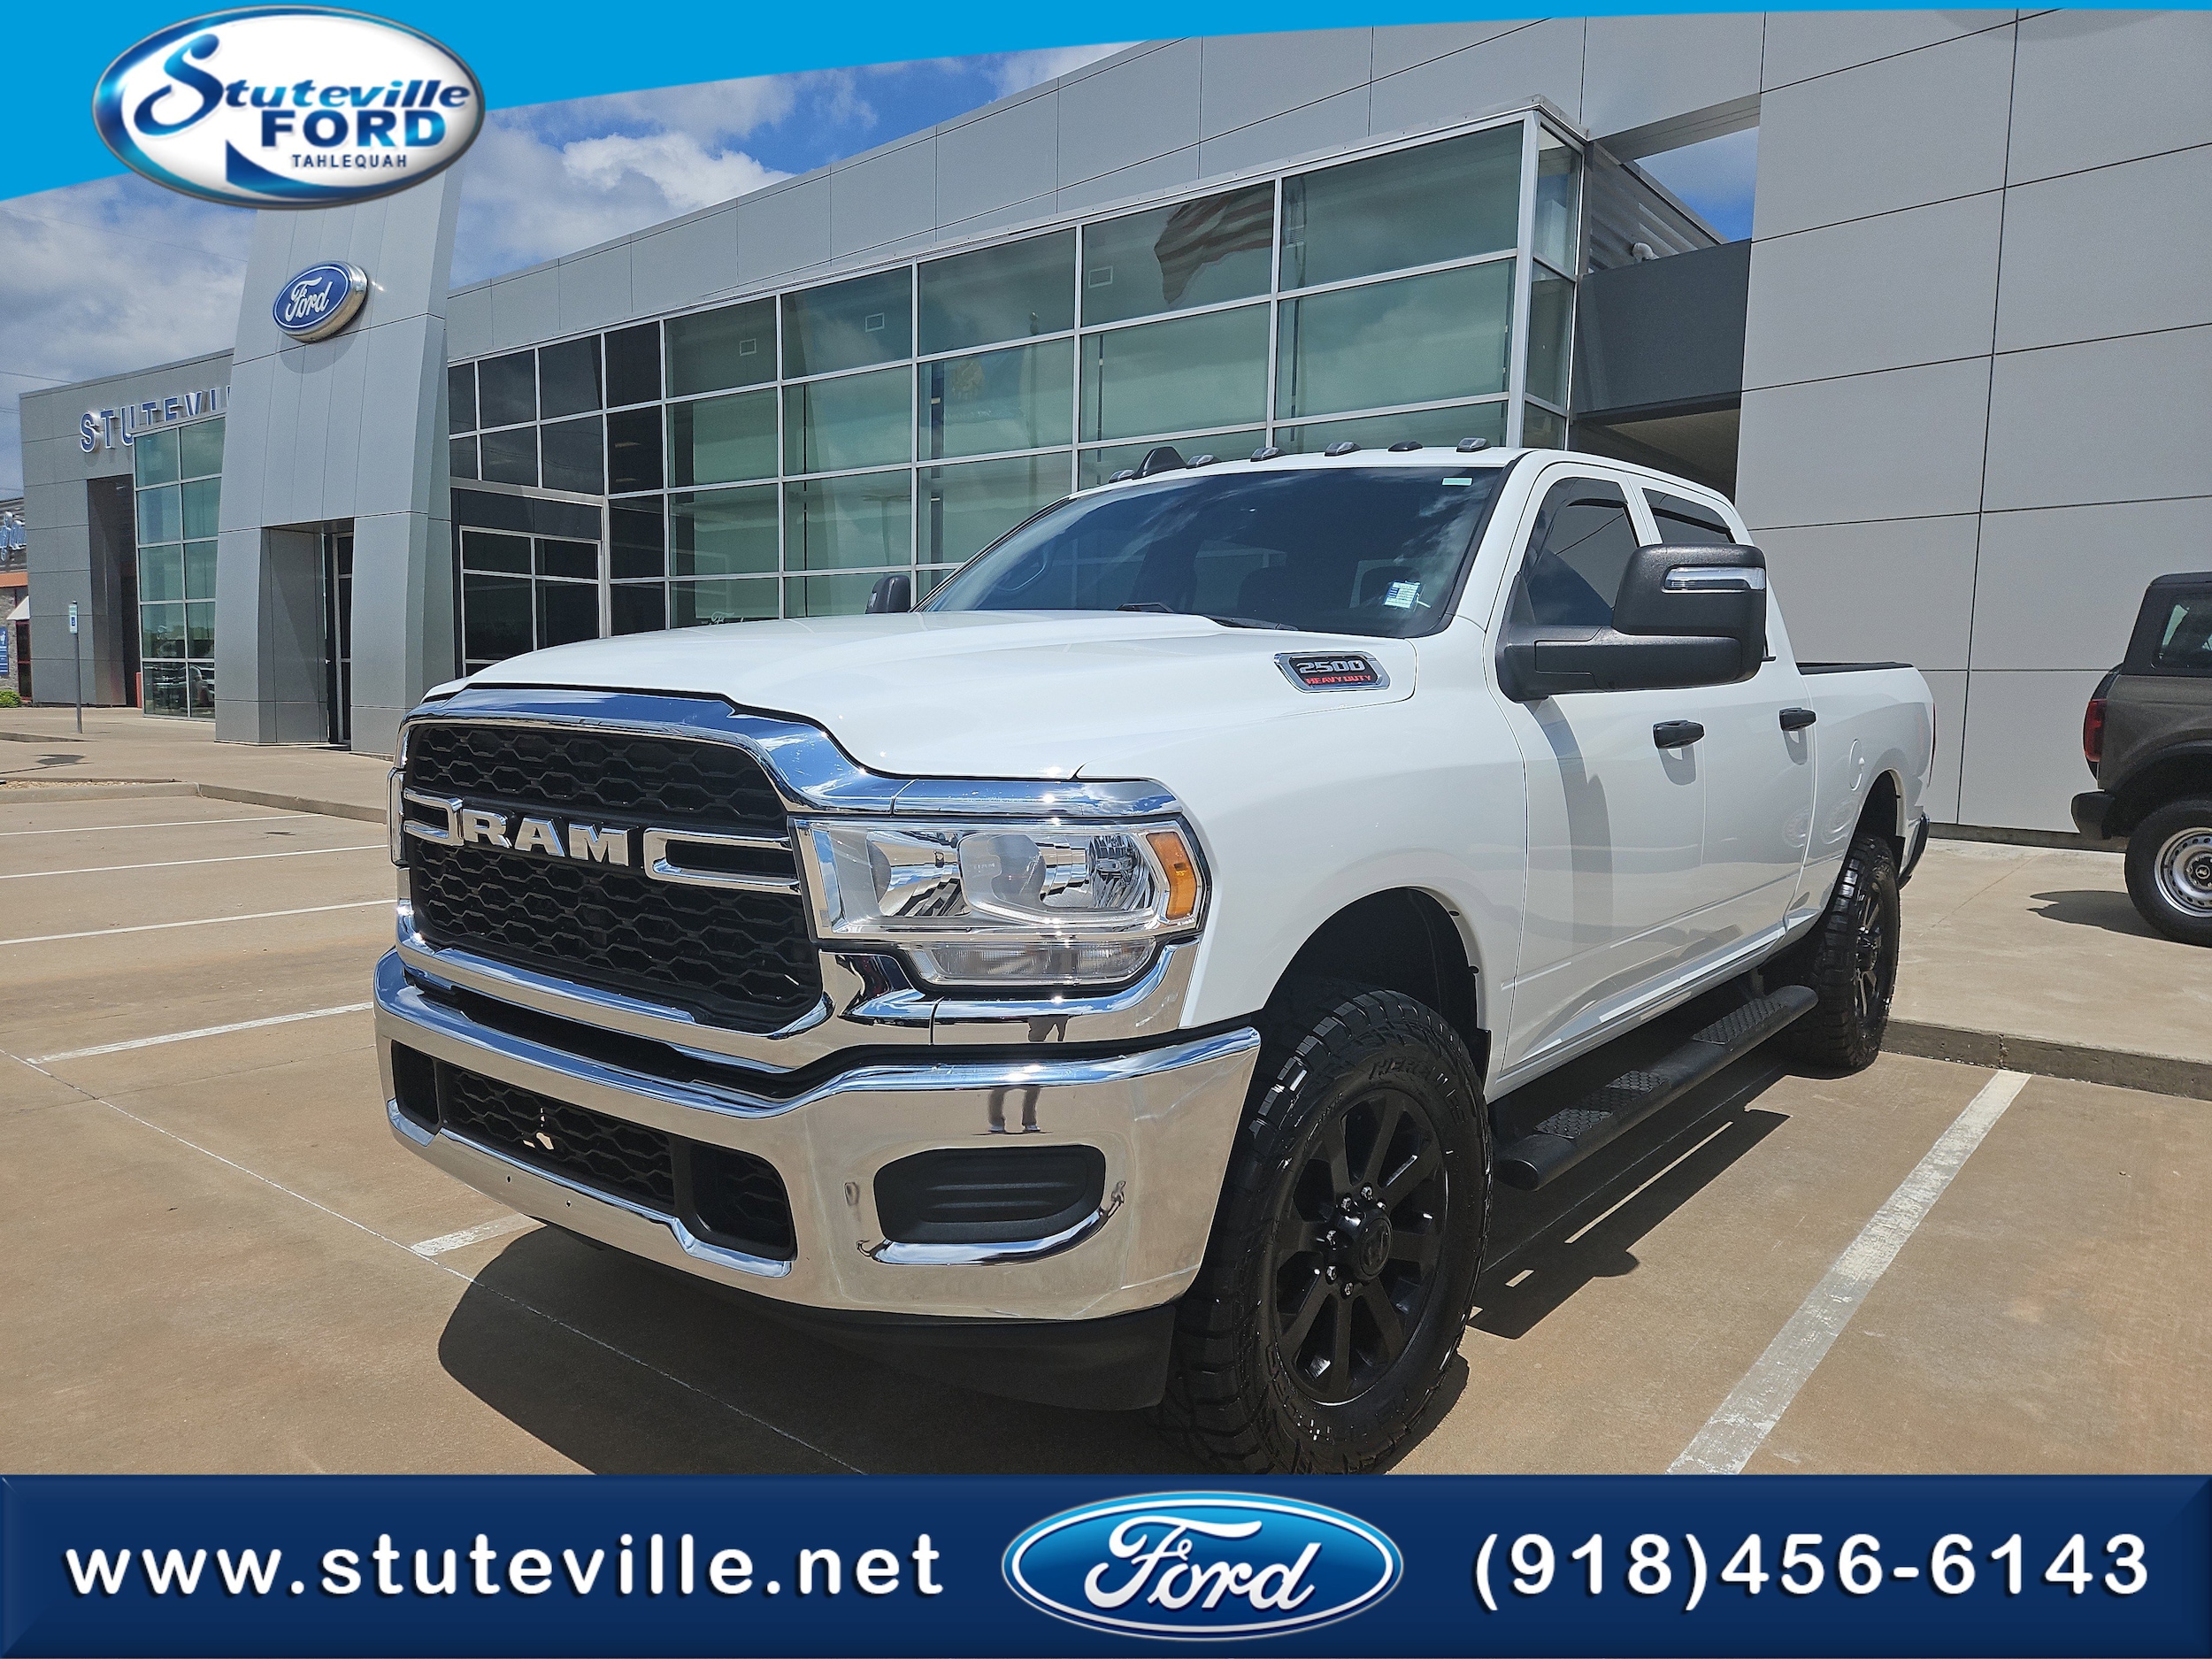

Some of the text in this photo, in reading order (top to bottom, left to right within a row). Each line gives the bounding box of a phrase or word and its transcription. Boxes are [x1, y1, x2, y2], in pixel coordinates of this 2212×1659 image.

[285, 276, 334, 322] Ford
[80, 384, 231, 453] STUTEVI
[1295, 659, 1366, 673] 2500
[1305, 675, 1342, 685] HEAVY
[462, 808, 630, 867] RAM
